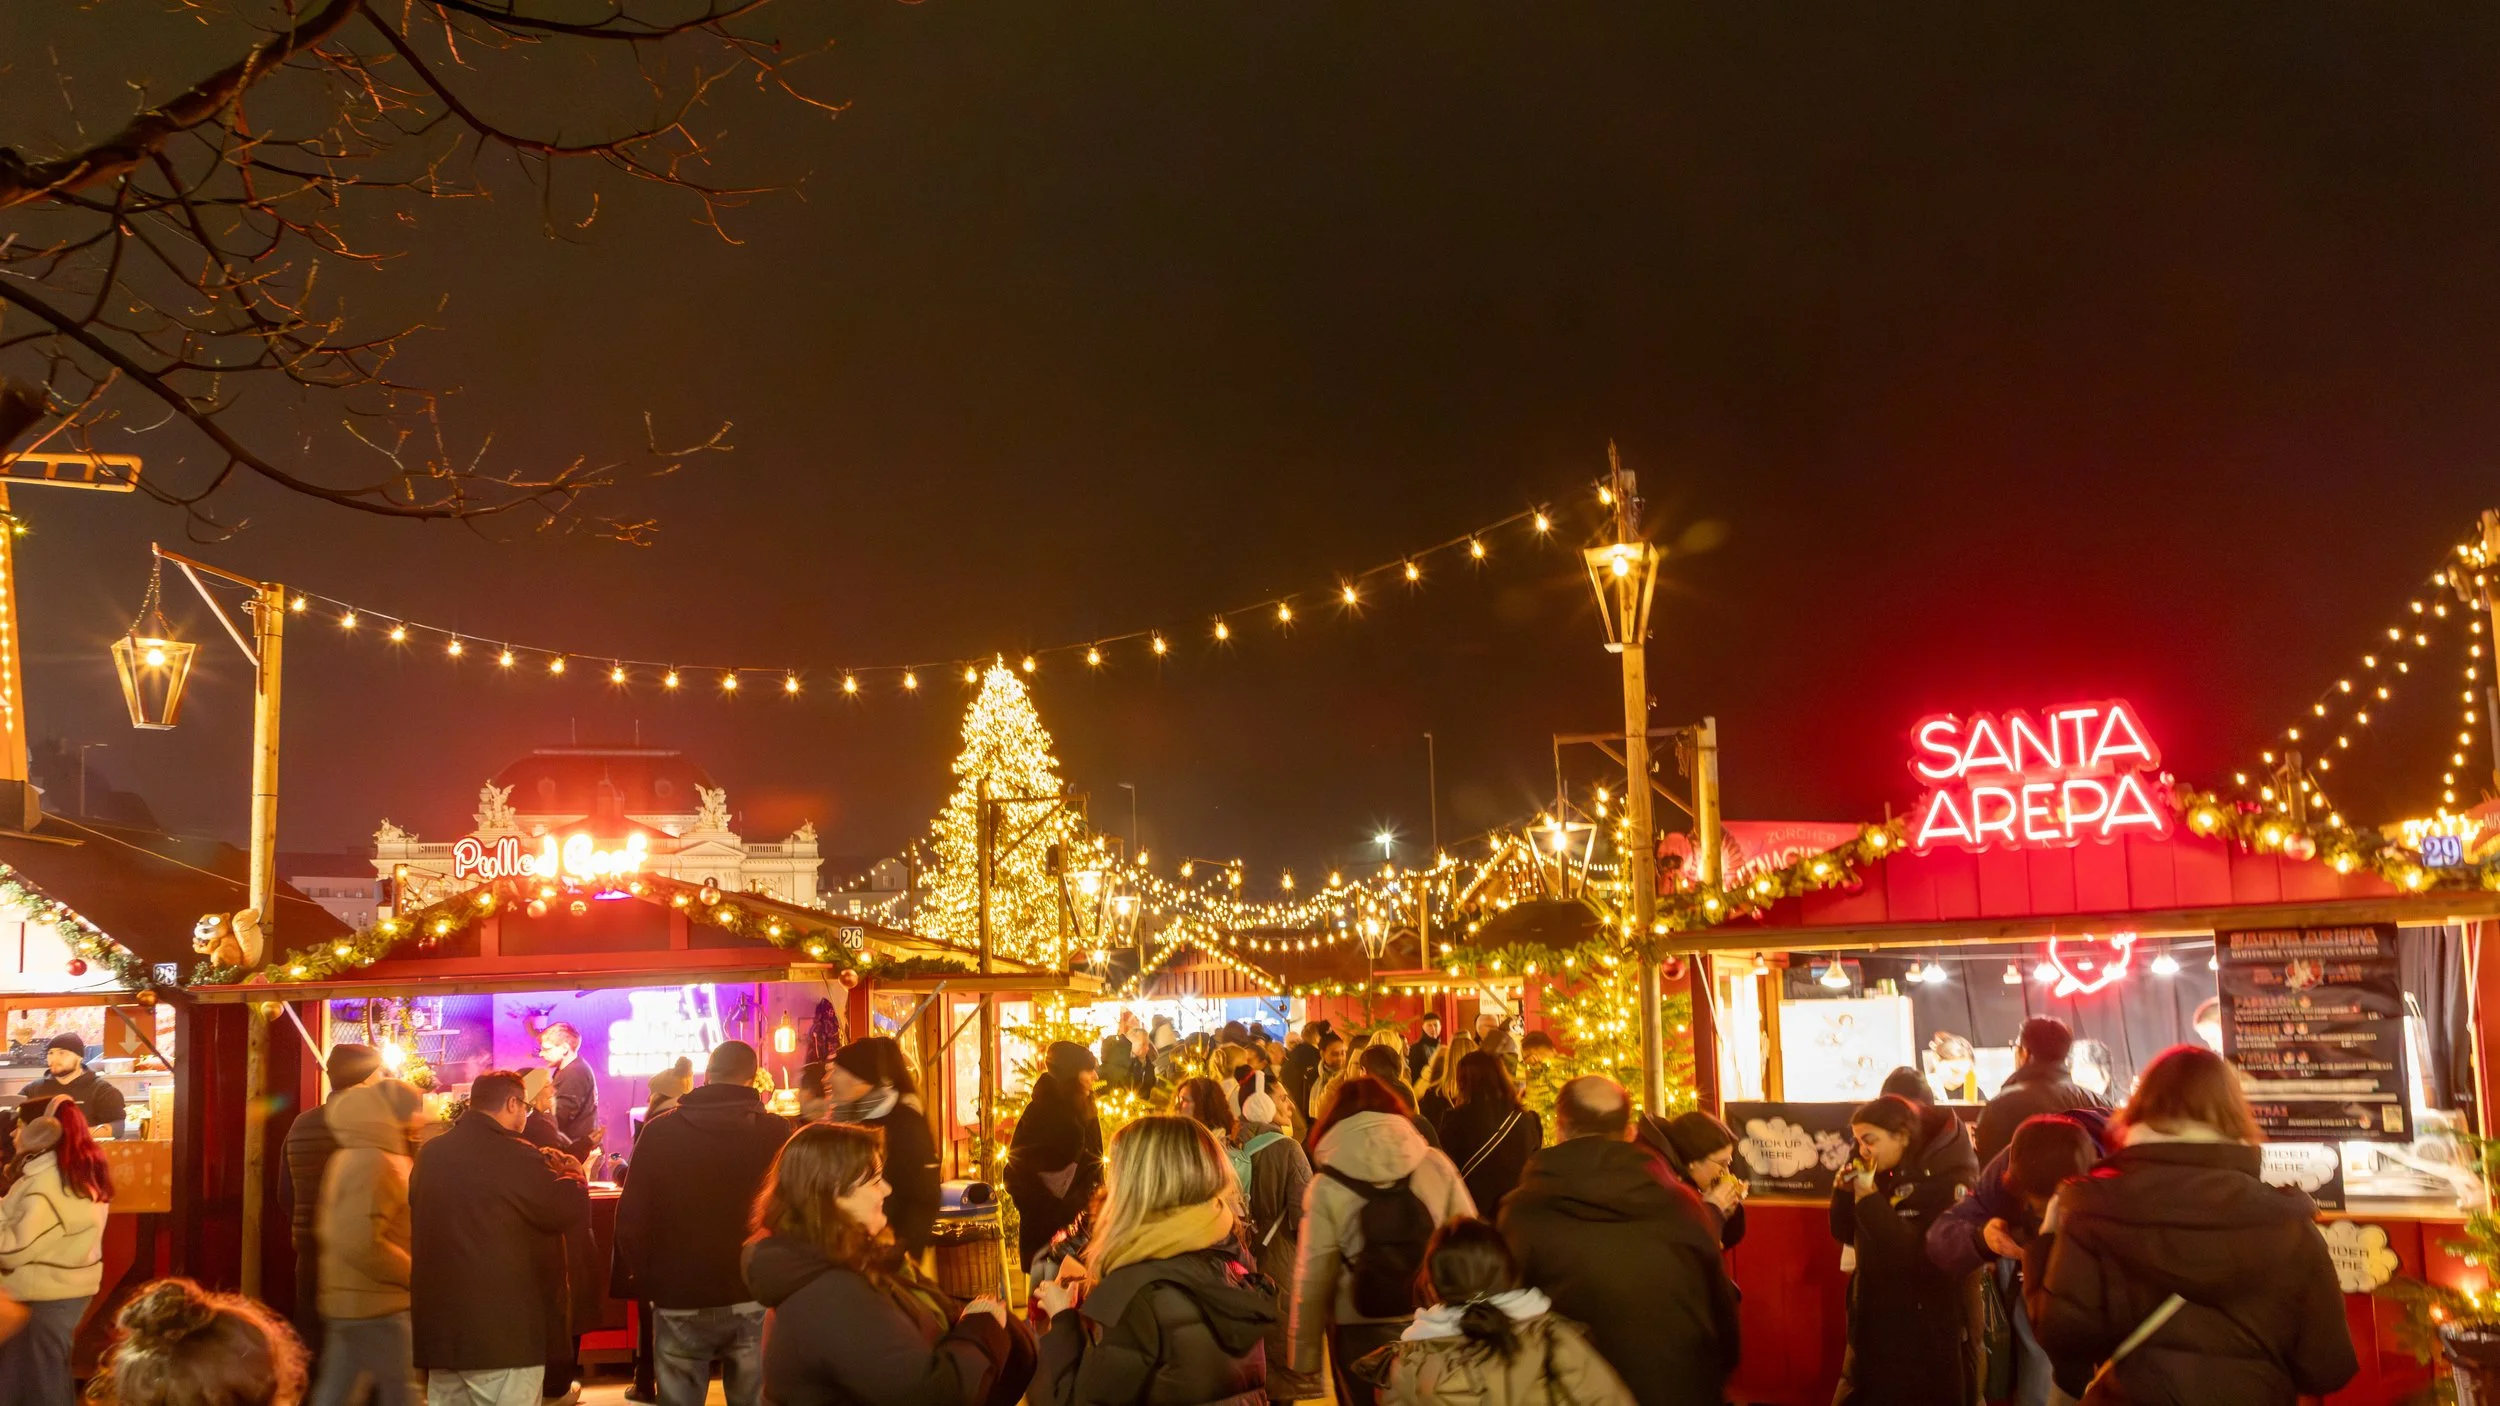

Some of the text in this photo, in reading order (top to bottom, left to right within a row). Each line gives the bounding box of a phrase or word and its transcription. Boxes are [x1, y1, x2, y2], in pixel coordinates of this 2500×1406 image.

[1916, 705, 2152, 779] SANTA
[1916, 774, 2163, 848] AREPA
[453, 834, 559, 879] Pulled
[2425, 836, 2460, 867] 29
[841, 928, 862, 948] 26
[1752, 1138, 1802, 1149] PICK UP
[1760, 1150, 1793, 1160] HERE
[2265, 1149, 2310, 1159] RDER
[2330, 1246, 2369, 1258] RDER
[2334, 1259, 2362, 1271] ERE
